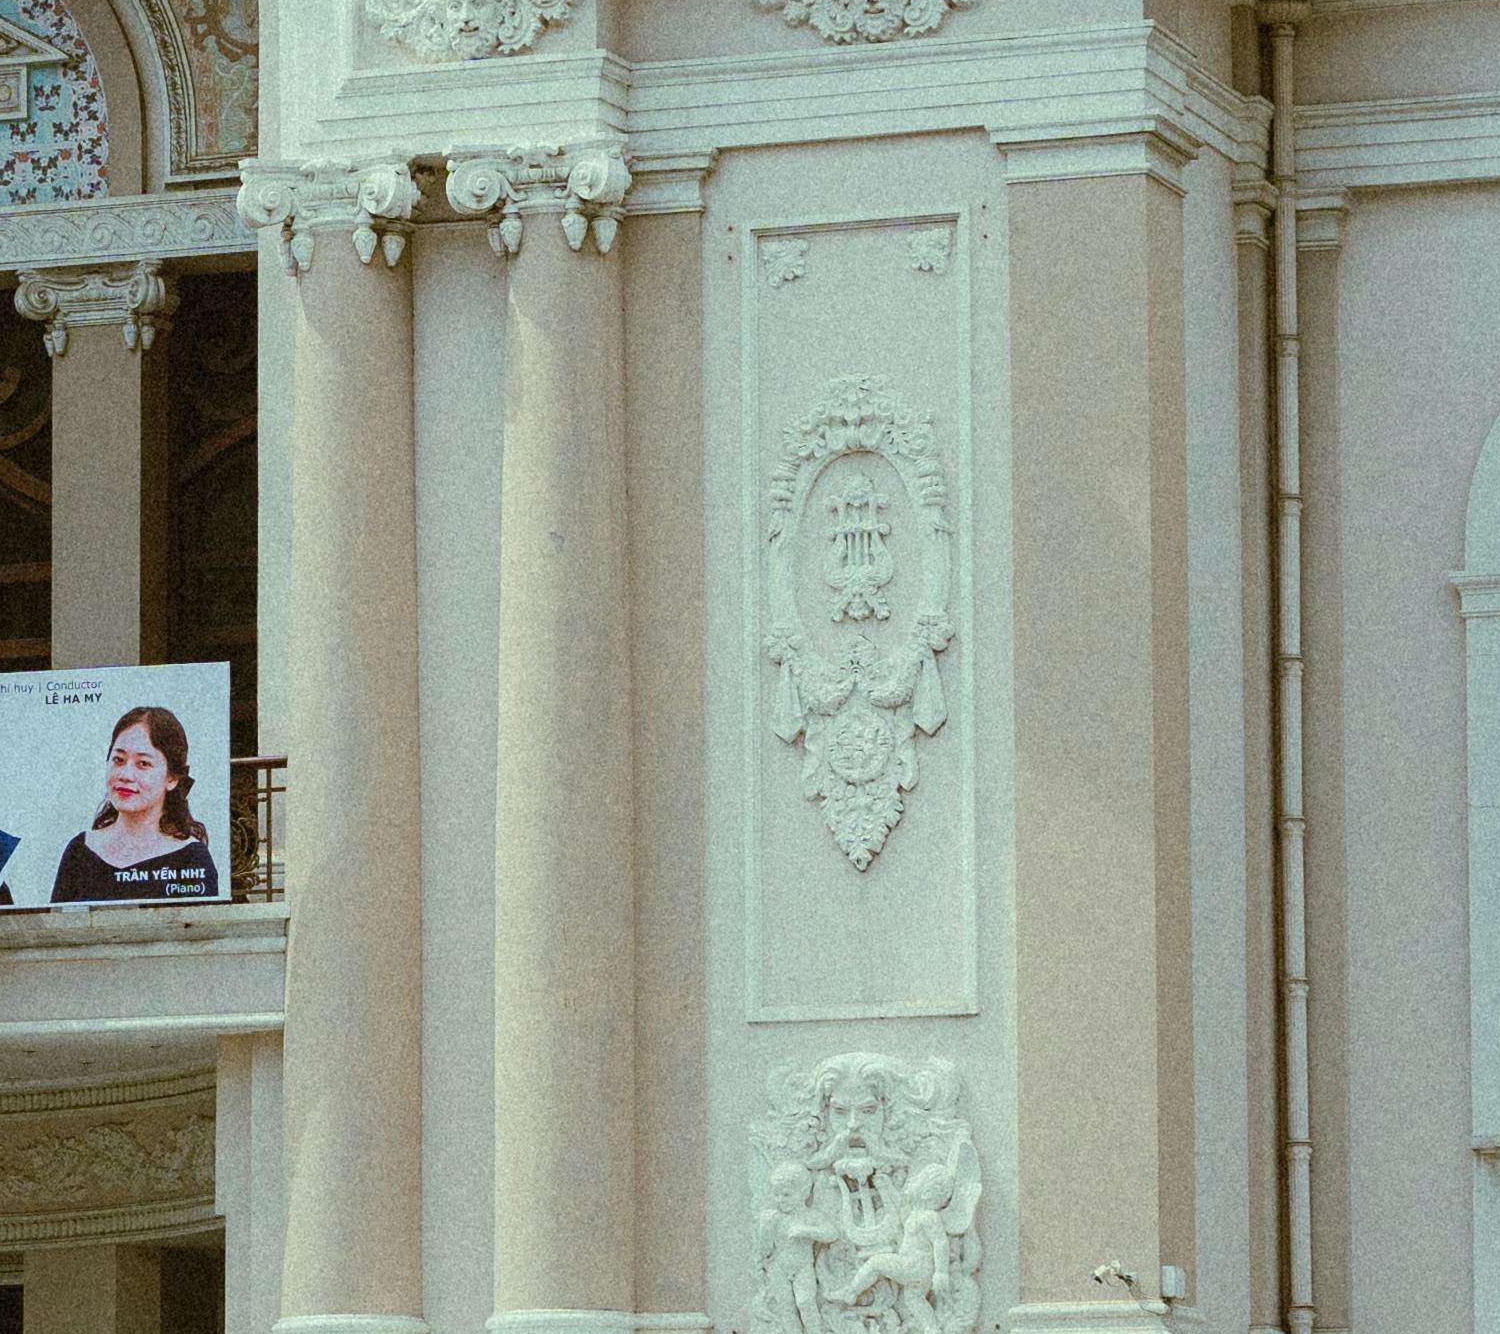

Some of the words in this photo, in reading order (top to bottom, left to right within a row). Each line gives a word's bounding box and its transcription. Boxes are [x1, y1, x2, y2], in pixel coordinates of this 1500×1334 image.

[13, 683, 34, 694] huy
[46, 680, 102, 692] Conductor
[45, 692, 58, 704] LÊ
[84, 692, 102, 703] MY
[180, 869, 205, 879] NHI
[166, 882, 206, 895] (Piano)
